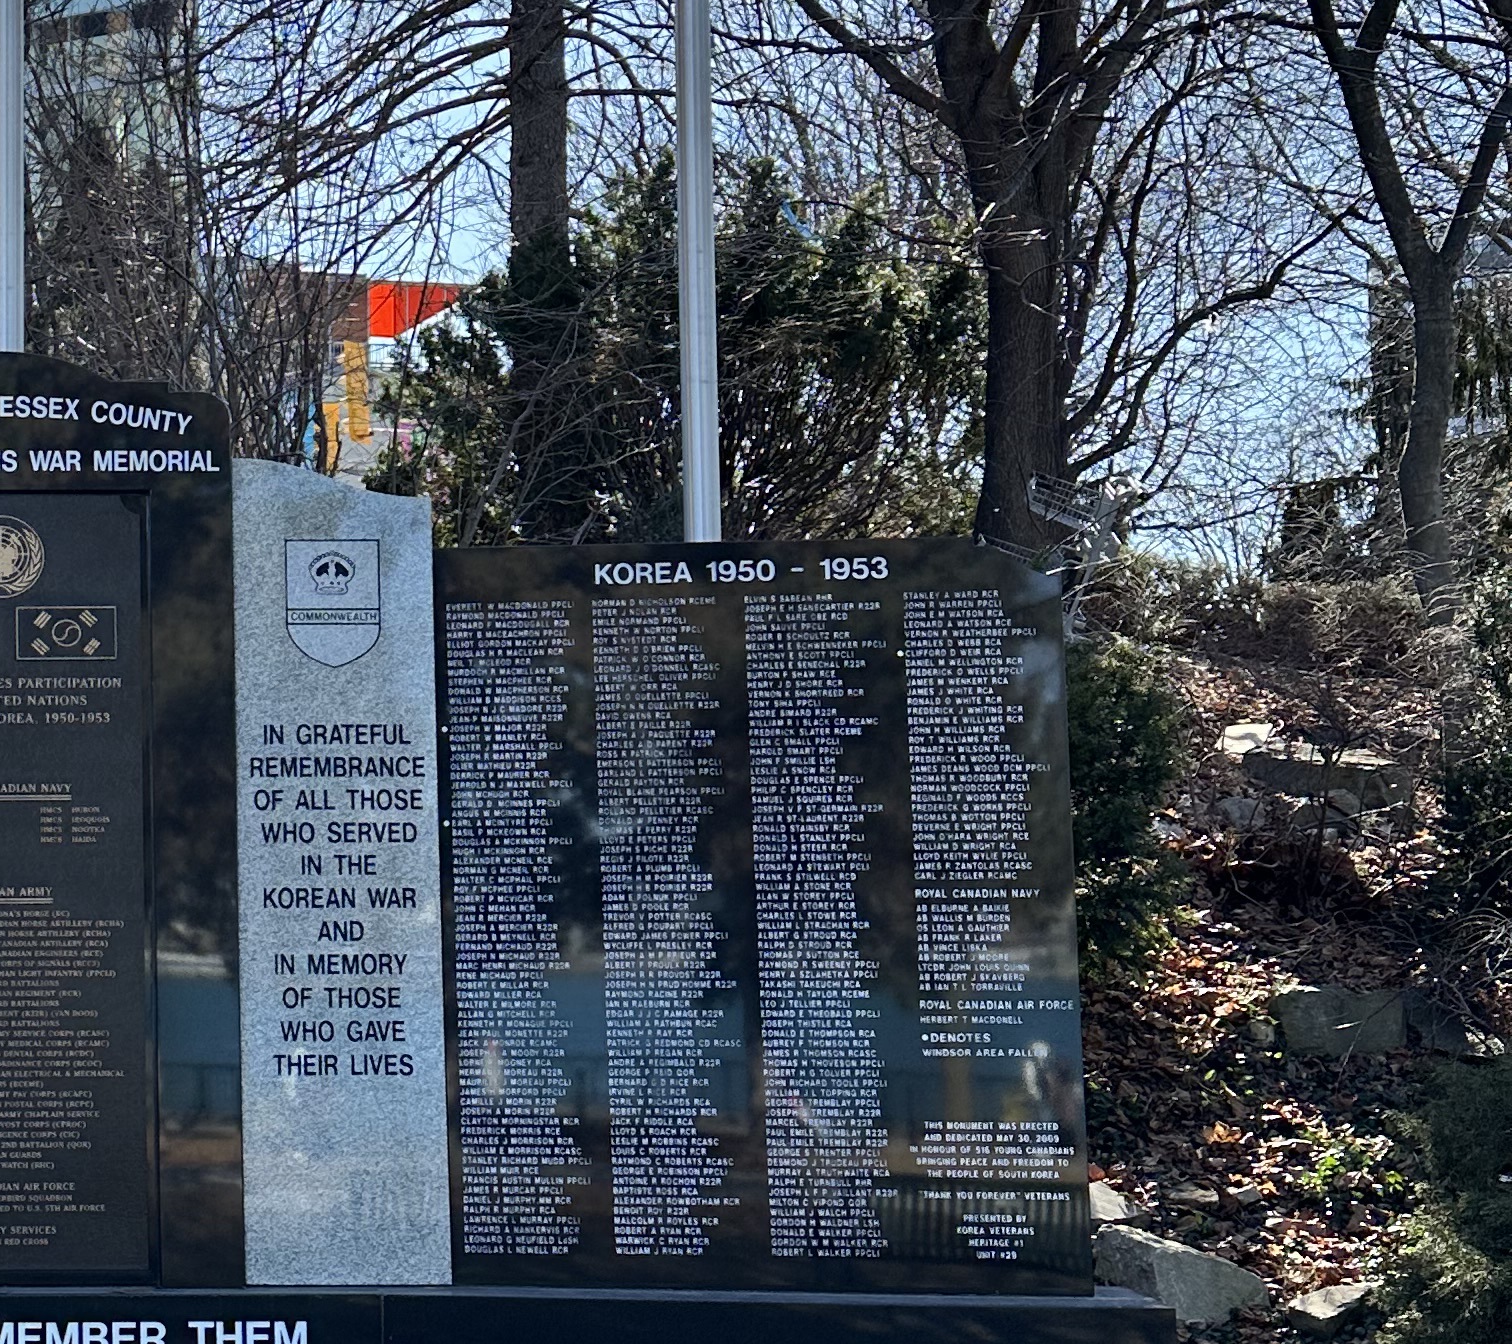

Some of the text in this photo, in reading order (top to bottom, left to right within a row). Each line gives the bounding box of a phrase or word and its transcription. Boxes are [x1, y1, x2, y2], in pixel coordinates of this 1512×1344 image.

[0, 395, 80, 420] ESSEX
[91, 400, 193, 435] COUNTY
[29, 449, 82, 472] WAR
[93, 449, 220, 472] MEMORIAL
[594, 562, 692, 585] KOREA
[706, 559, 776, 582] 1950
[819, 557, 889, 580] 1953
[291, 612, 377, 621] COMMONWEALTH
[18, 678, 122, 690] PARTICIPATION
[27, 695, 87, 706] NATIONS
[45, 713, 110, 725] 1950-1953
[263, 724, 411, 745] IN GRATEFUL
[250, 757, 426, 778] REMEMBRANCE
[41, 784, 72, 794] NAVY
[254, 789, 423, 811] OF ALL THOSE
[261, 822, 418, 843] WHO SERVED
[301, 855, 377, 876] IN THE
[19, 887, 52, 897] ARMY
[915, 889, 1040, 898] ROYAL CANADIAN NAVY
[263, 887, 417, 909] KOREAN WAR
[317, 921, 364, 942] AND
[274, 954, 407, 975] IN MEMORY
[282, 987, 401, 1009] OF THOSE
[919, 1000, 1074, 1010] ROYAL CANADIAN AIR FORCE
[280, 1021, 406, 1042] WHO GAVE
[930, 1033, 991, 1043] DENOTES
[922, 1048, 971, 1057] WINDSOR
[976, 1048, 1004, 1057] AREA
[273, 1054, 414, 1076] THEIR LIVES
[924, 1122, 1059, 1131] THIS MONUMENT WAS ERECTED
[924, 1134, 1059, 1142] AND DEDICATED MAY 30, 2009
[910, 1146, 1074, 1155] IN HONOUR OF 516 YOUNG CANADIANS
[916, 1158, 1069, 1167] BRINGING PEACE AND FREEDOM TO
[927, 1170, 1060, 1179] THE PEOPLE OF SOUTH KOREA
[23, 1182, 40, 1191] AIR
[43, 1182, 75, 1191] FORCE
[963, 1215, 1026, 1223] PRESENTED BY
[10, 1226, 57, 1235] SERVICES
[957, 1227, 1035, 1235] KOREA VETERANS
[968, 1239, 1009, 1247] HERITAGE
